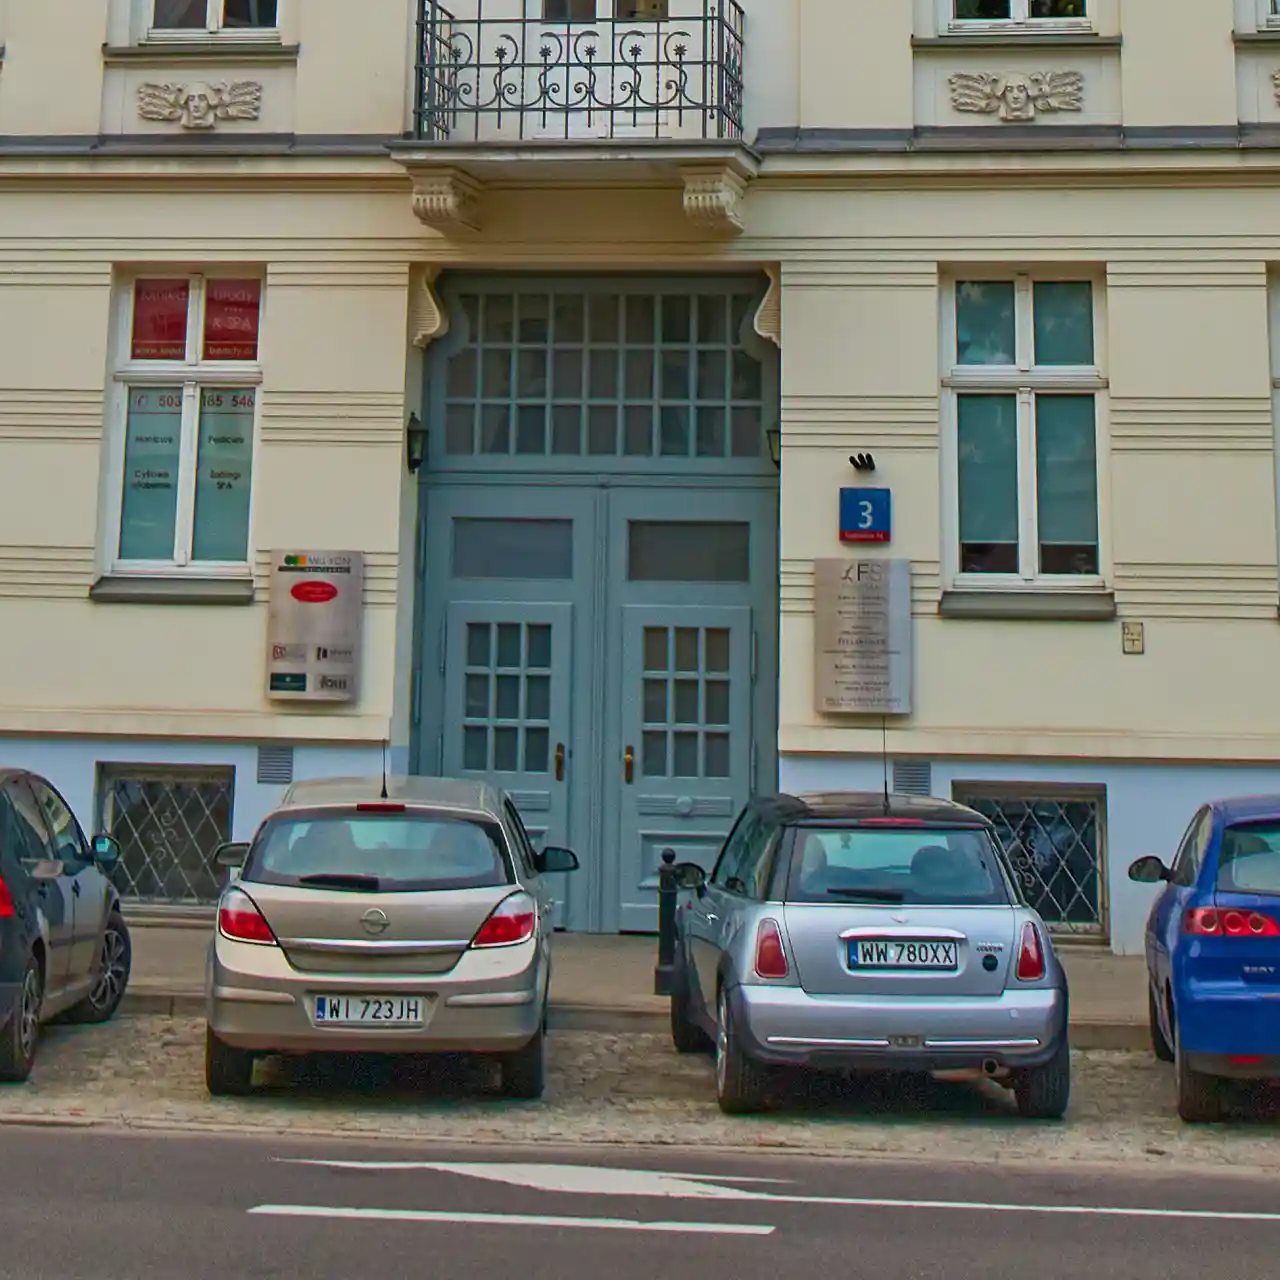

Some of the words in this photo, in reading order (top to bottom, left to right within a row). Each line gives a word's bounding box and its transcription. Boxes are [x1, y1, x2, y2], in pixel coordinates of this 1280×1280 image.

[158, 395, 181, 408] 503
[231, 395, 254, 408] 546
[857, 500, 874, 529] 3
[861, 943, 888, 963] WW
[894, 943, 954, 964] 780XX
[329, 998, 350, 1019] WI
[360, 999, 419, 1020] 723JH
